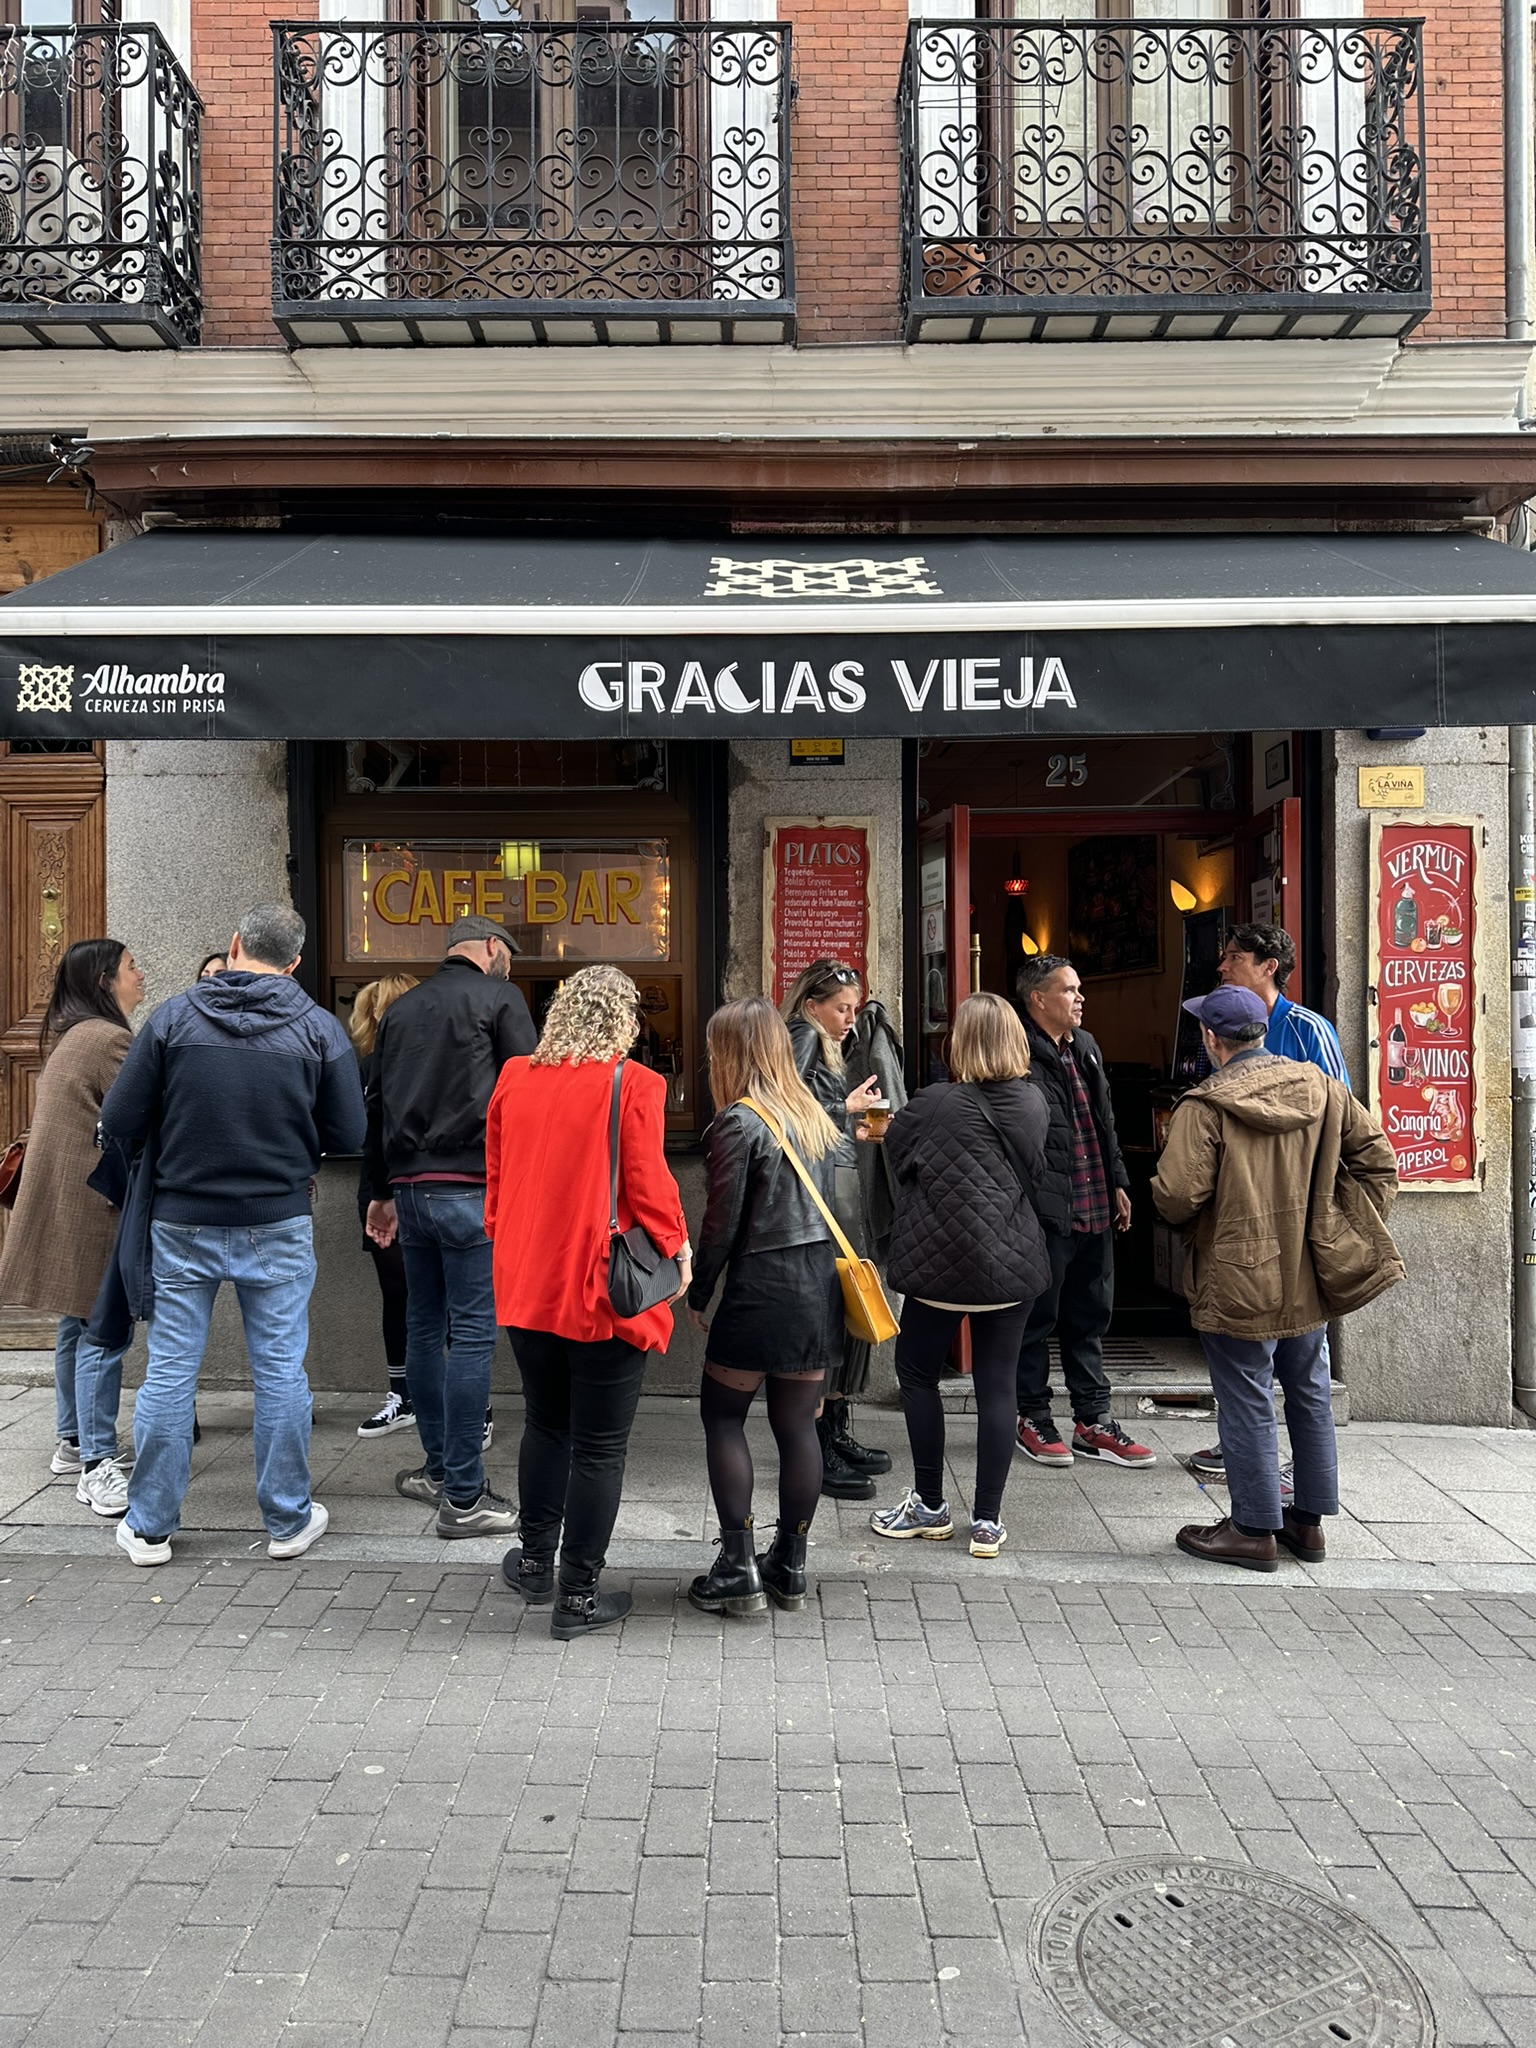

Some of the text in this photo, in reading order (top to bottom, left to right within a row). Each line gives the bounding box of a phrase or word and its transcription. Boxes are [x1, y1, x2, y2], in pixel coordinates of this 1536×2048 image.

[79, 664, 226, 697] Alhambra
[577, 656, 1078, 715] GRACIAS VIEJA
[84, 699, 226, 713] CERVEZA SIN PRISA
[1046, 753, 1089, 787] 25
[1377, 778, 1414, 788] LA VIÑA
[785, 842, 861, 868] PLATOS
[1387, 843, 1465, 885] VERMUT
[373, 855, 643, 925] CAFÉ BAR
[809, 949, 815, 958] 2
[1385, 959, 1466, 987] CERVEZAS
[1420, 1048, 1470, 1078] VINOS
[1387, 1105, 1442, 1140] Sangría
[1397, 1147, 1449, 1171] APEROL
